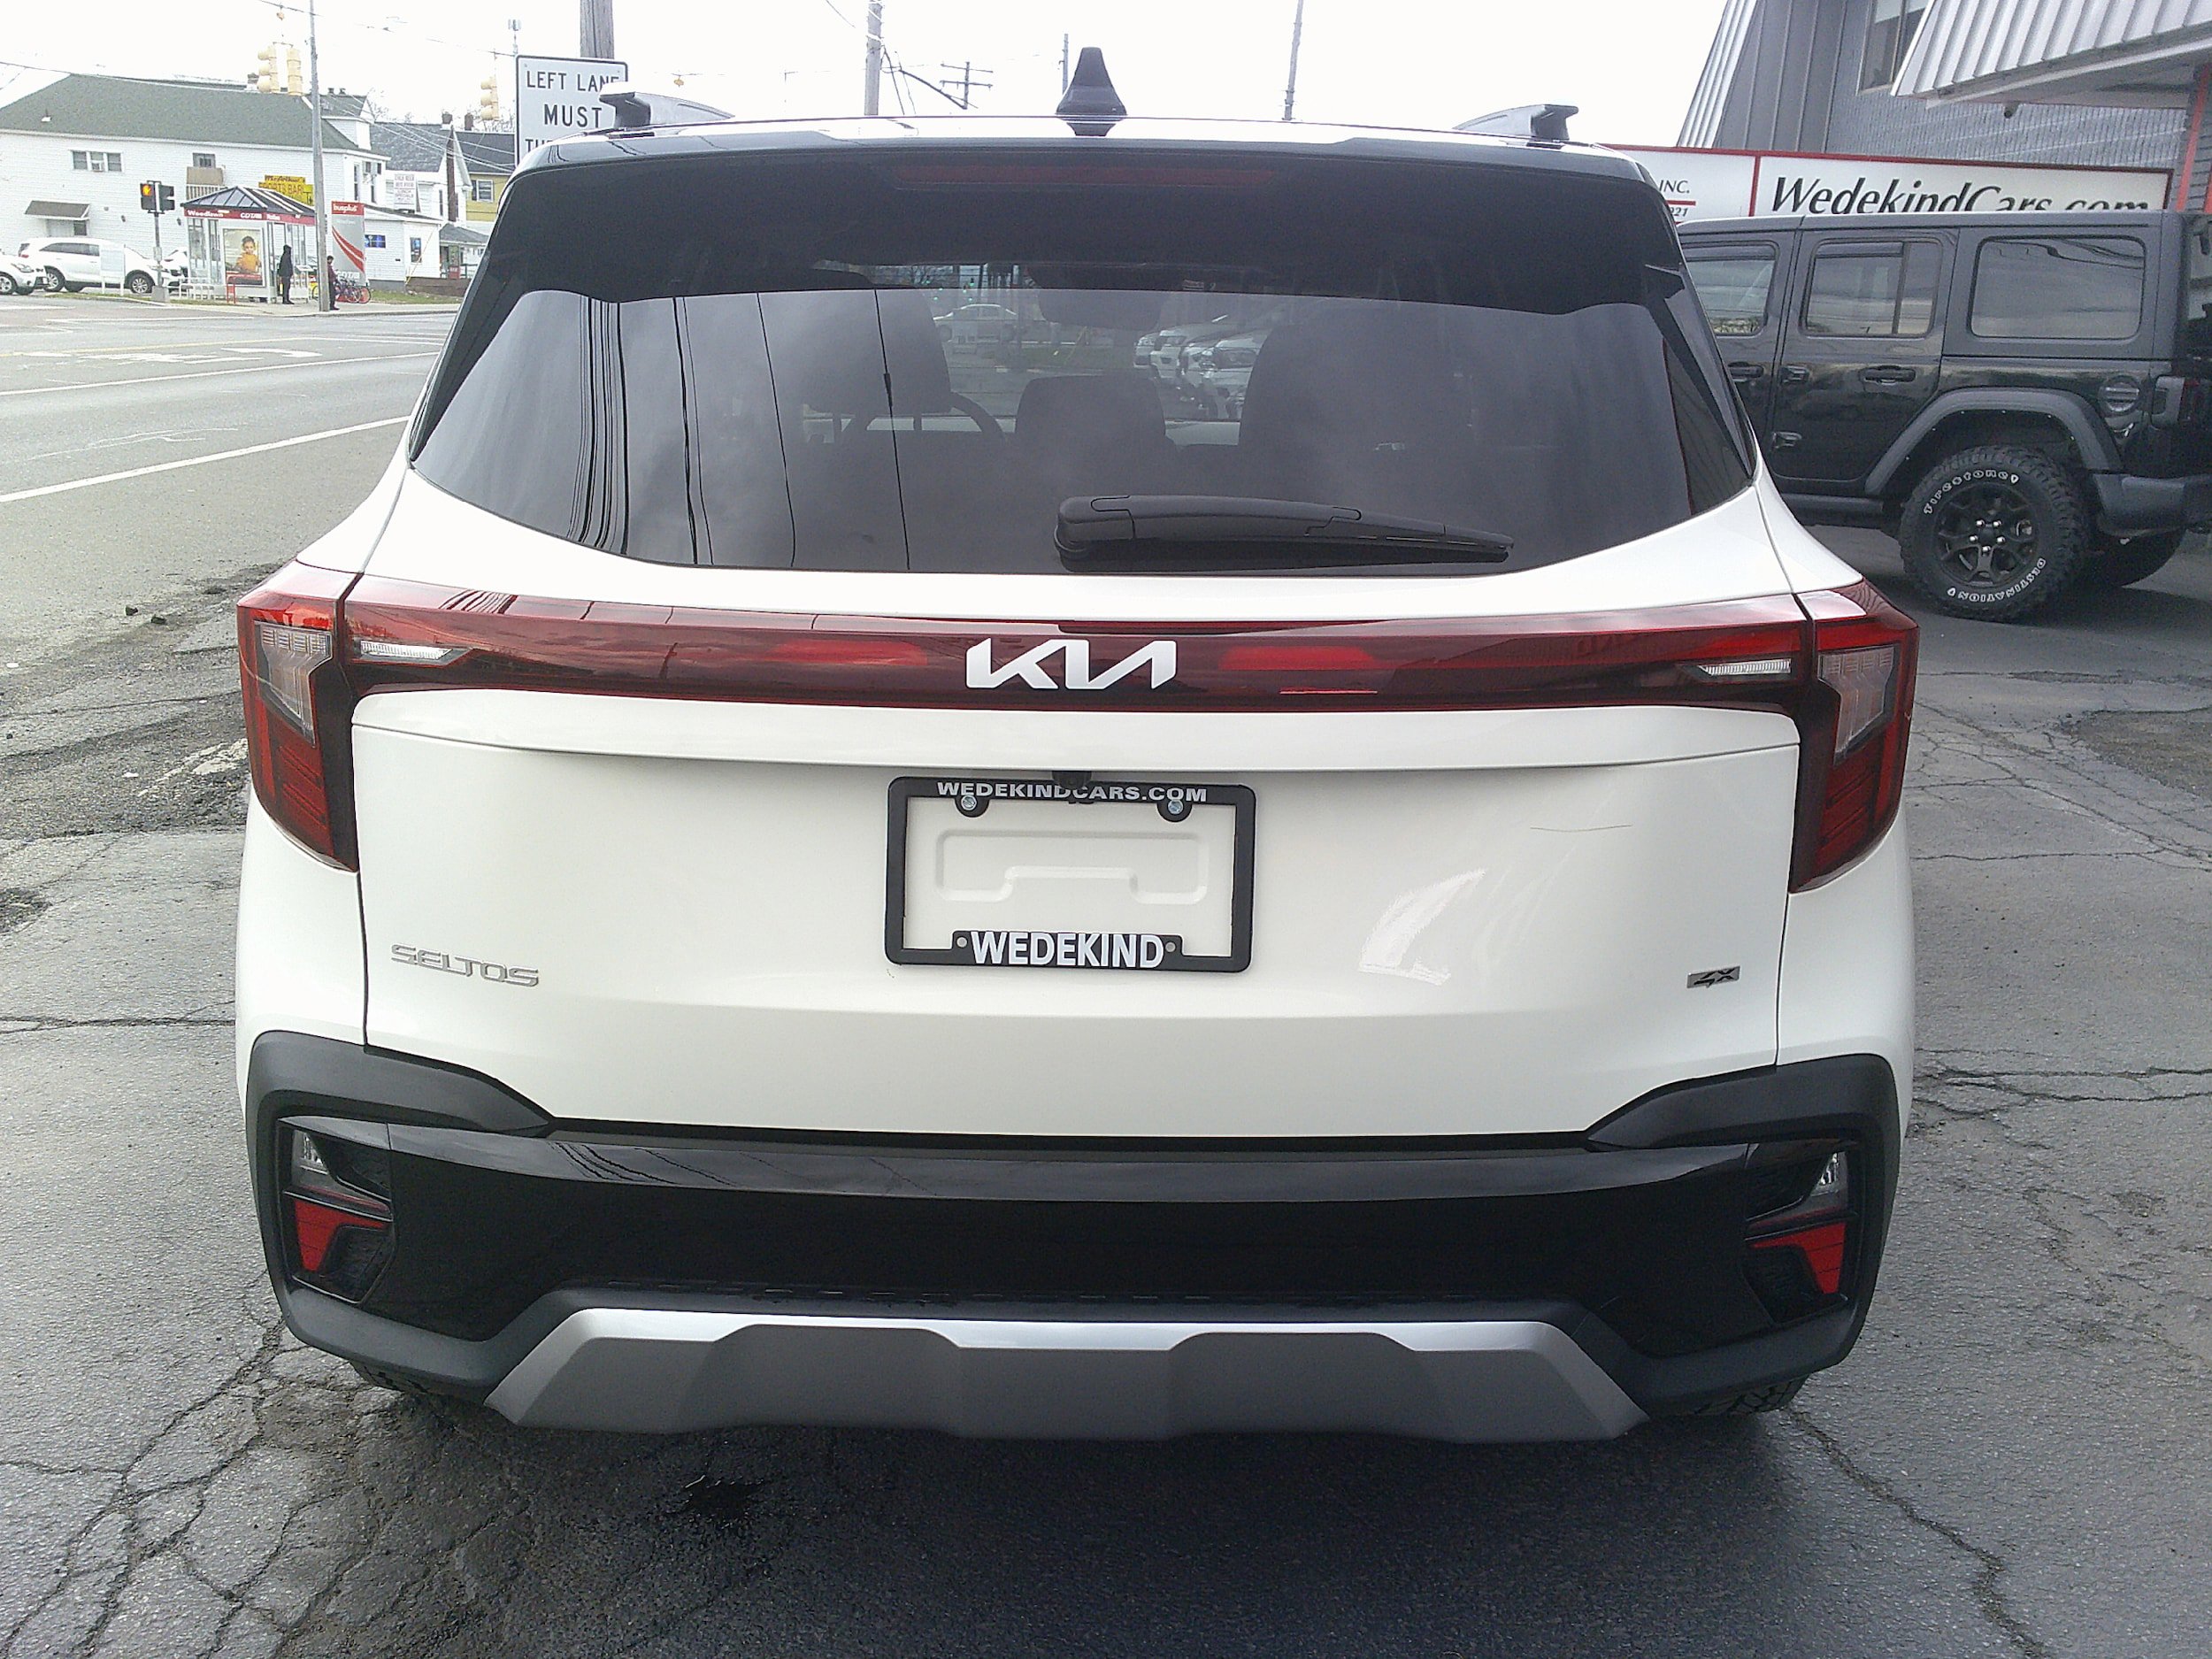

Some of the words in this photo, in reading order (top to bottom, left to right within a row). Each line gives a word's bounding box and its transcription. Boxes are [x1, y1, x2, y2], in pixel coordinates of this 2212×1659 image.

[526, 71, 566, 89] LEFT
[544, 104, 603, 128] MUST
[1659, 180, 1690, 194] INC.
[1770, 175, 2149, 214] WedekindCars
[1957, 557, 2047, 603] DESTINATION
[966, 637, 1177, 690] KIA
[936, 781, 1208, 803] WEDEKINDCARS.COM
[391, 943, 539, 987] SELTOS
[971, 930, 1164, 969] WEDEKIND
